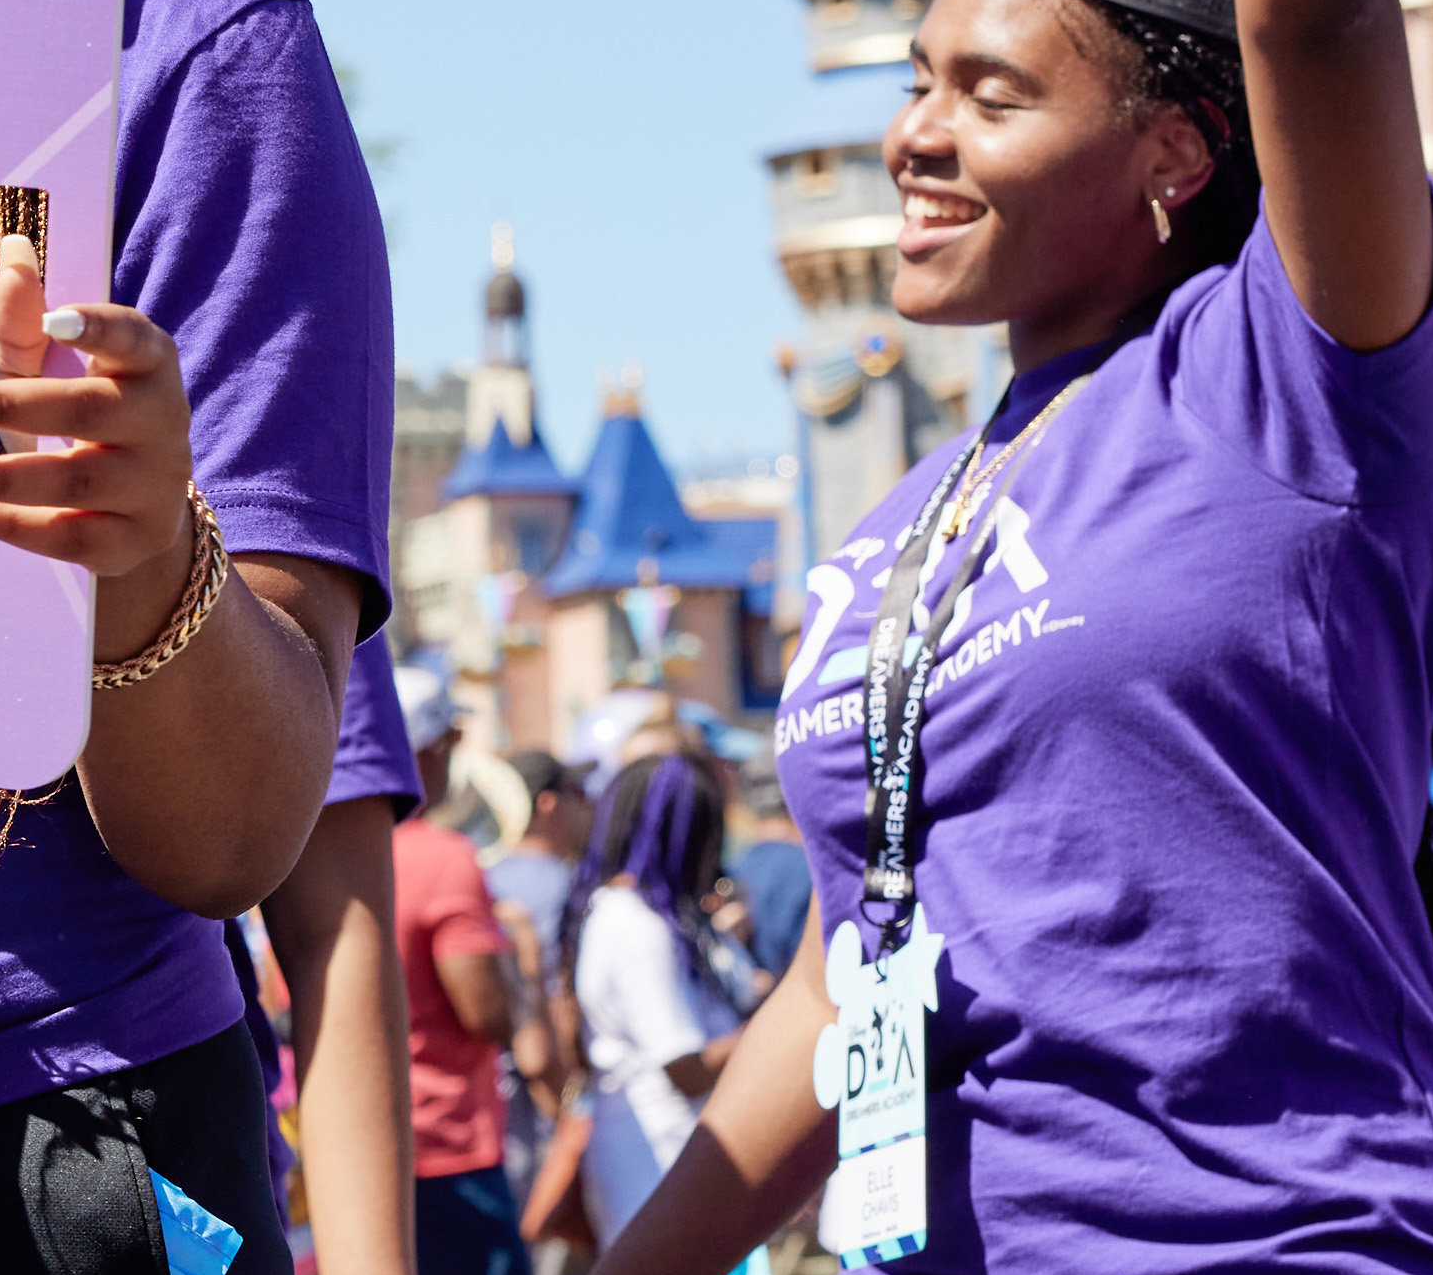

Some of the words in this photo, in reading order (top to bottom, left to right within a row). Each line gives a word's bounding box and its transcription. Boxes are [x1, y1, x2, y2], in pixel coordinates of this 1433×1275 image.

[868, 617, 897, 745] DREAMERS
[924, 599, 1051, 698] ADEMY
[895, 646, 934, 780] ACADEMY
[867, 1165, 895, 1194] ELLE
